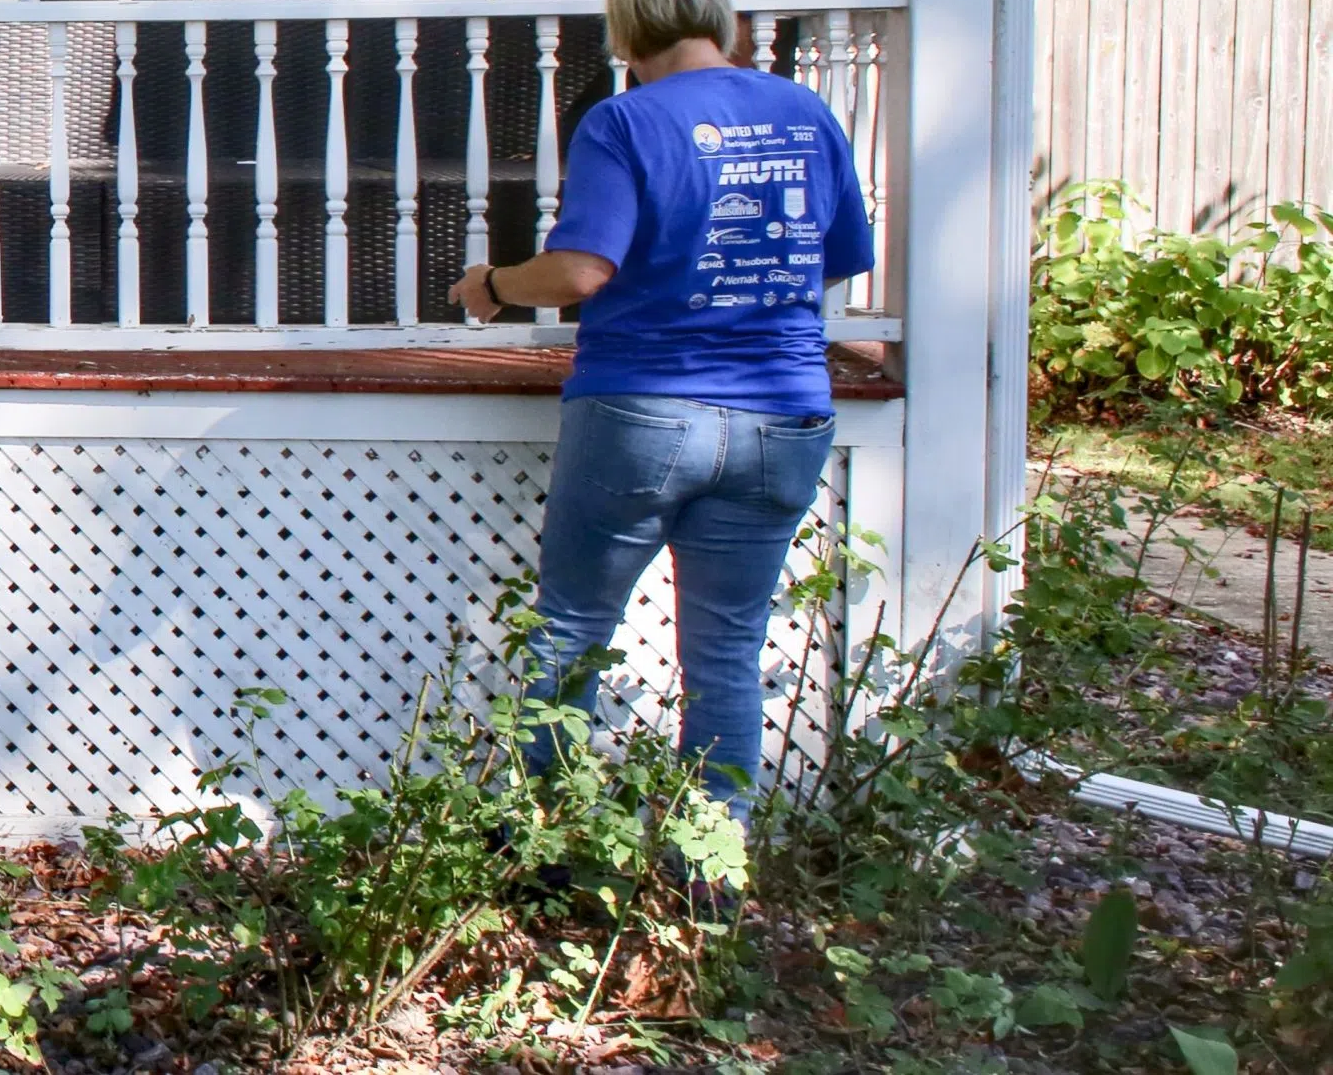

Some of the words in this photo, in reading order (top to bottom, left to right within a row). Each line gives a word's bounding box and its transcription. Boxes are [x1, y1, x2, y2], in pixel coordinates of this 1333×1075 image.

[752, 123, 773, 136] WAY
[793, 132, 814, 141] 2025
[718, 158, 806, 185] MUTH
[724, 274, 760, 285] Nemak
